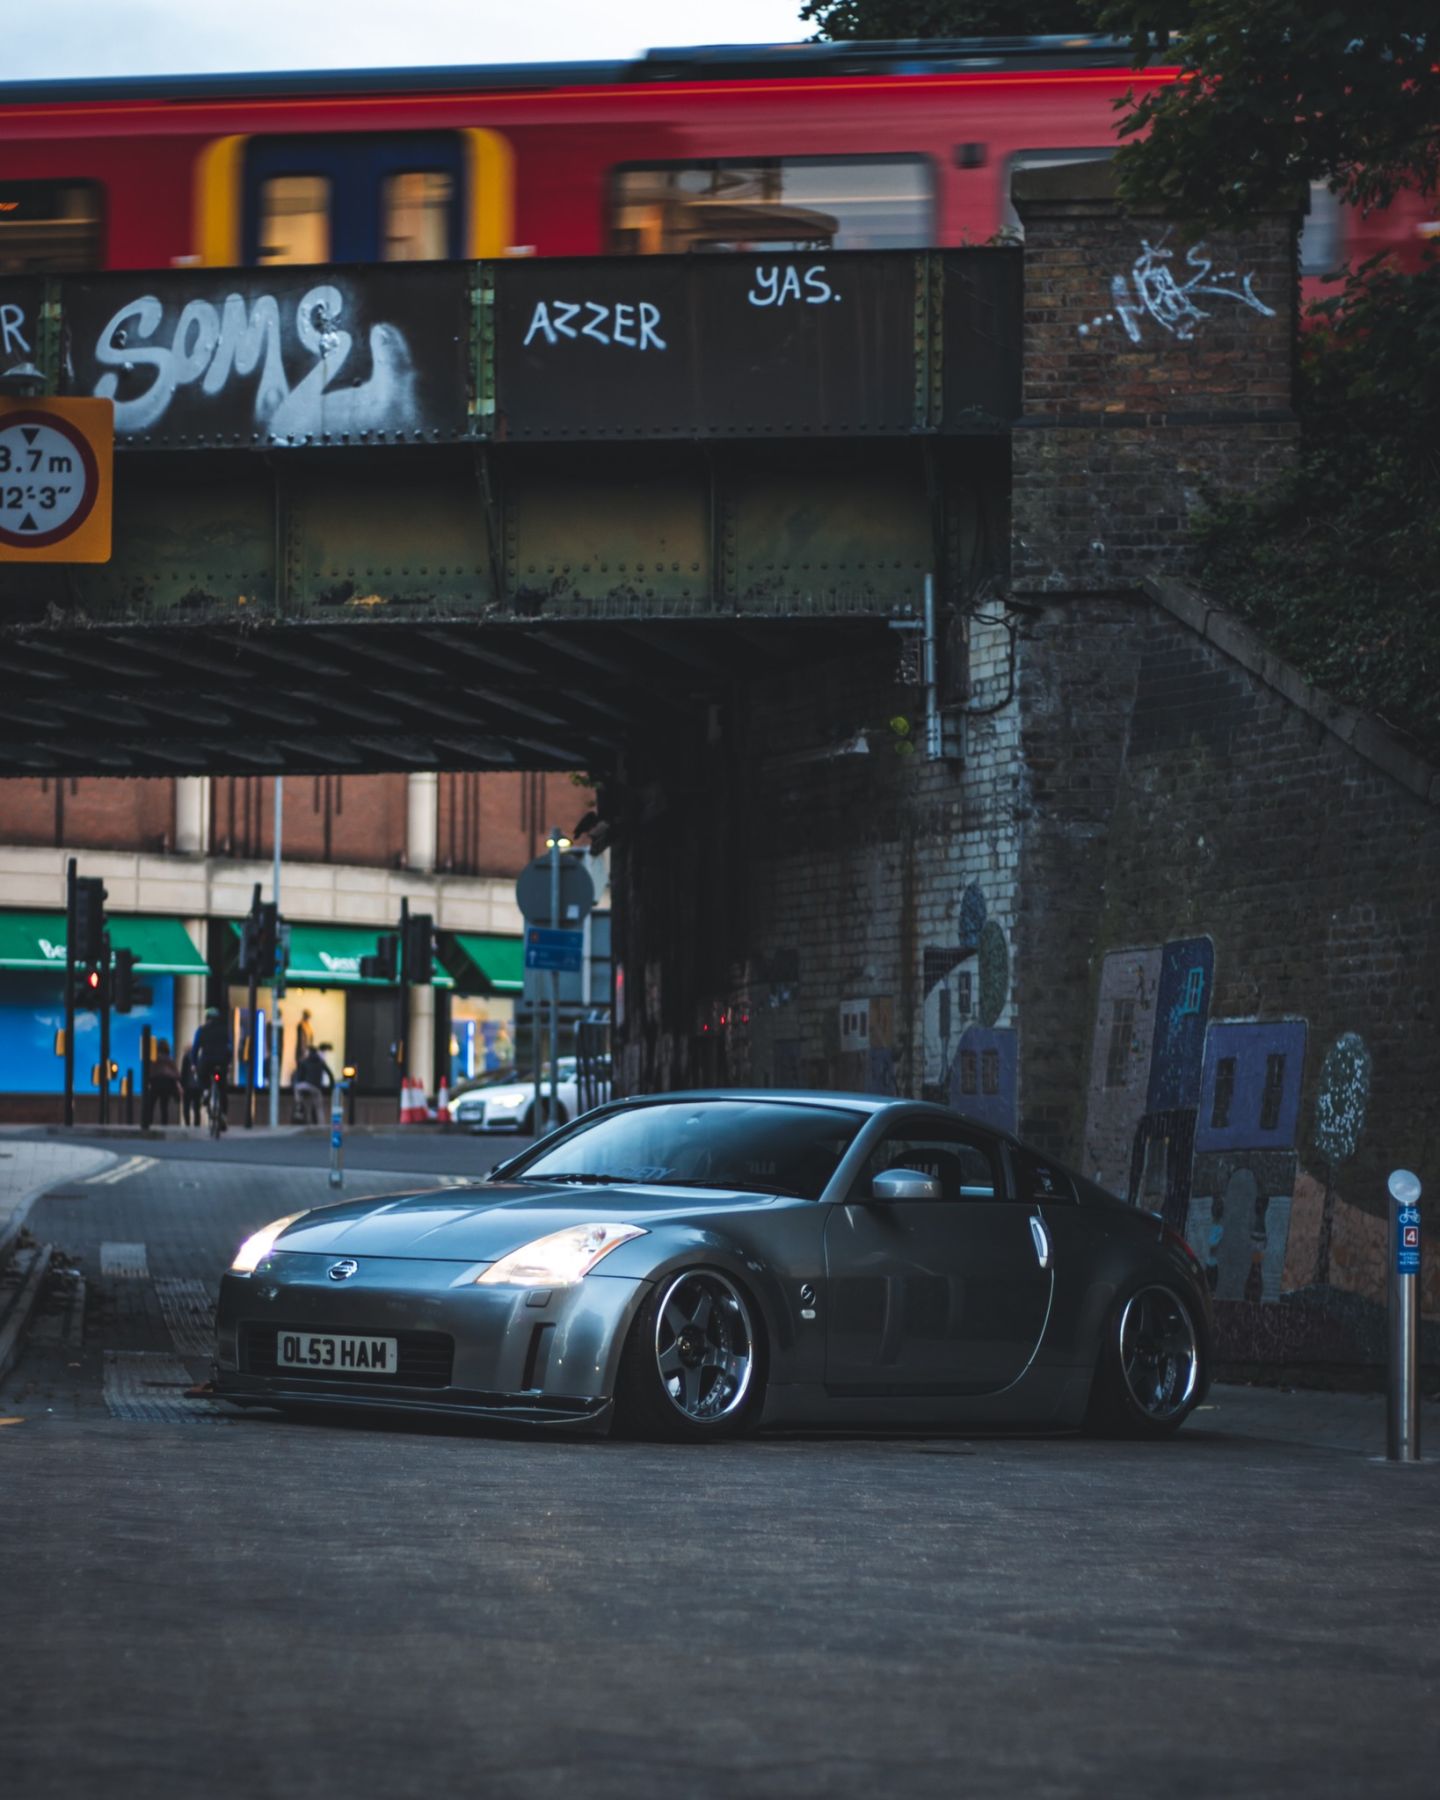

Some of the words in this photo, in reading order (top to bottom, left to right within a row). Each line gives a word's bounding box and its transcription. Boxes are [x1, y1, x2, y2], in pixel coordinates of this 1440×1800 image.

[749, 265, 842, 306] YAS.
[0, 304, 31, 354] R
[523, 301, 667, 350] AZZER
[1406, 1229, 1417, 1244] 4
[283, 1335, 336, 1366] OL53
[340, 1340, 387, 1369] HAM
